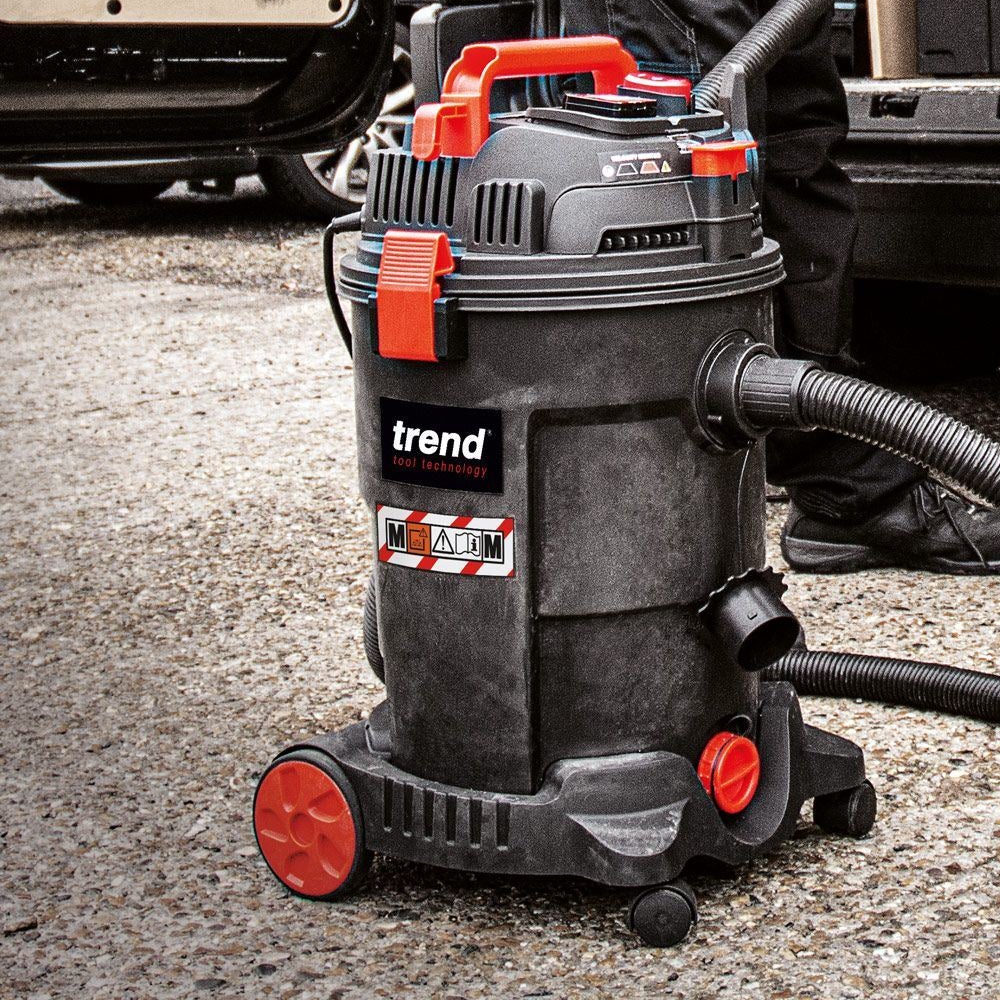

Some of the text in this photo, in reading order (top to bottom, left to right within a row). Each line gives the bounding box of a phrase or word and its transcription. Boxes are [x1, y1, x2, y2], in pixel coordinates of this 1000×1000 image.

[392, 420, 486, 460] trend
[392, 455, 488, 478] tool technology
[388, 522, 502, 560] M M
